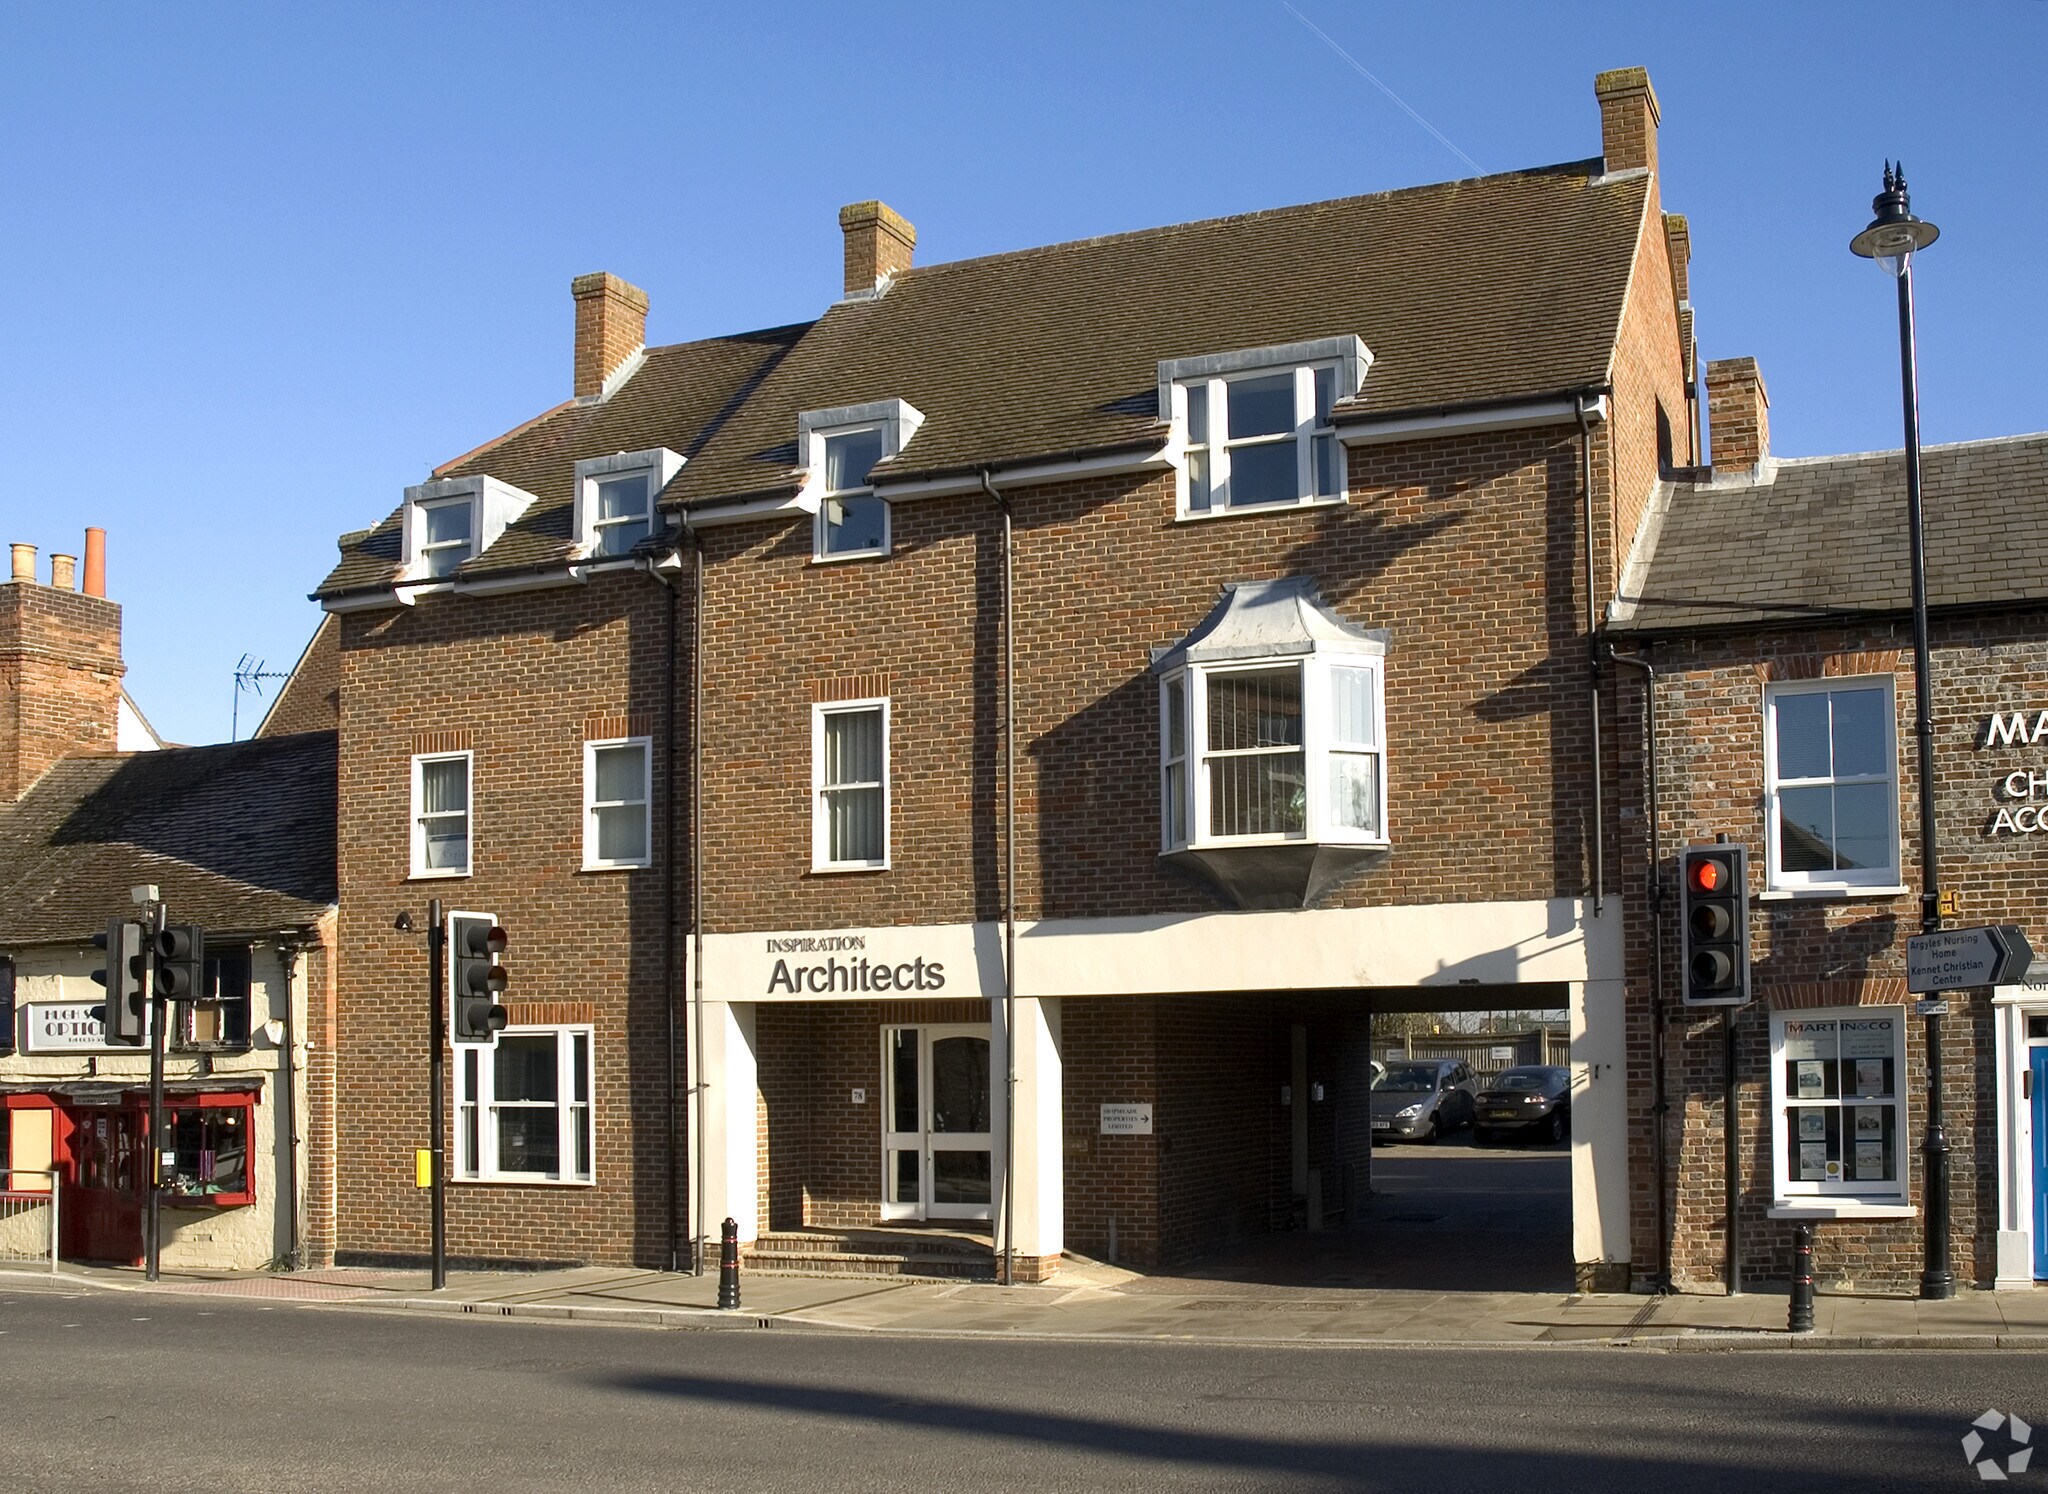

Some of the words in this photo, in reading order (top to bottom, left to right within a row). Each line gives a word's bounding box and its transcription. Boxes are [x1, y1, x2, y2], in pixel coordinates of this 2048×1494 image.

[766, 935, 866, 953] INSPIRATION
[1910, 939, 1942, 950] Argyles
[1944, 934, 1979, 946] Nursing
[1931, 949, 1957, 959] Home
[767, 956, 946, 994] Architects
[1911, 963, 1941, 976] Kennet
[1943, 960, 1984, 973] Christian
[1932, 974, 1963, 985] Centre
[45, 1009, 80, 1020] HUGH
[45, 1021, 105, 1036] OPTICI
[853, 1091, 863, 1101] 78
